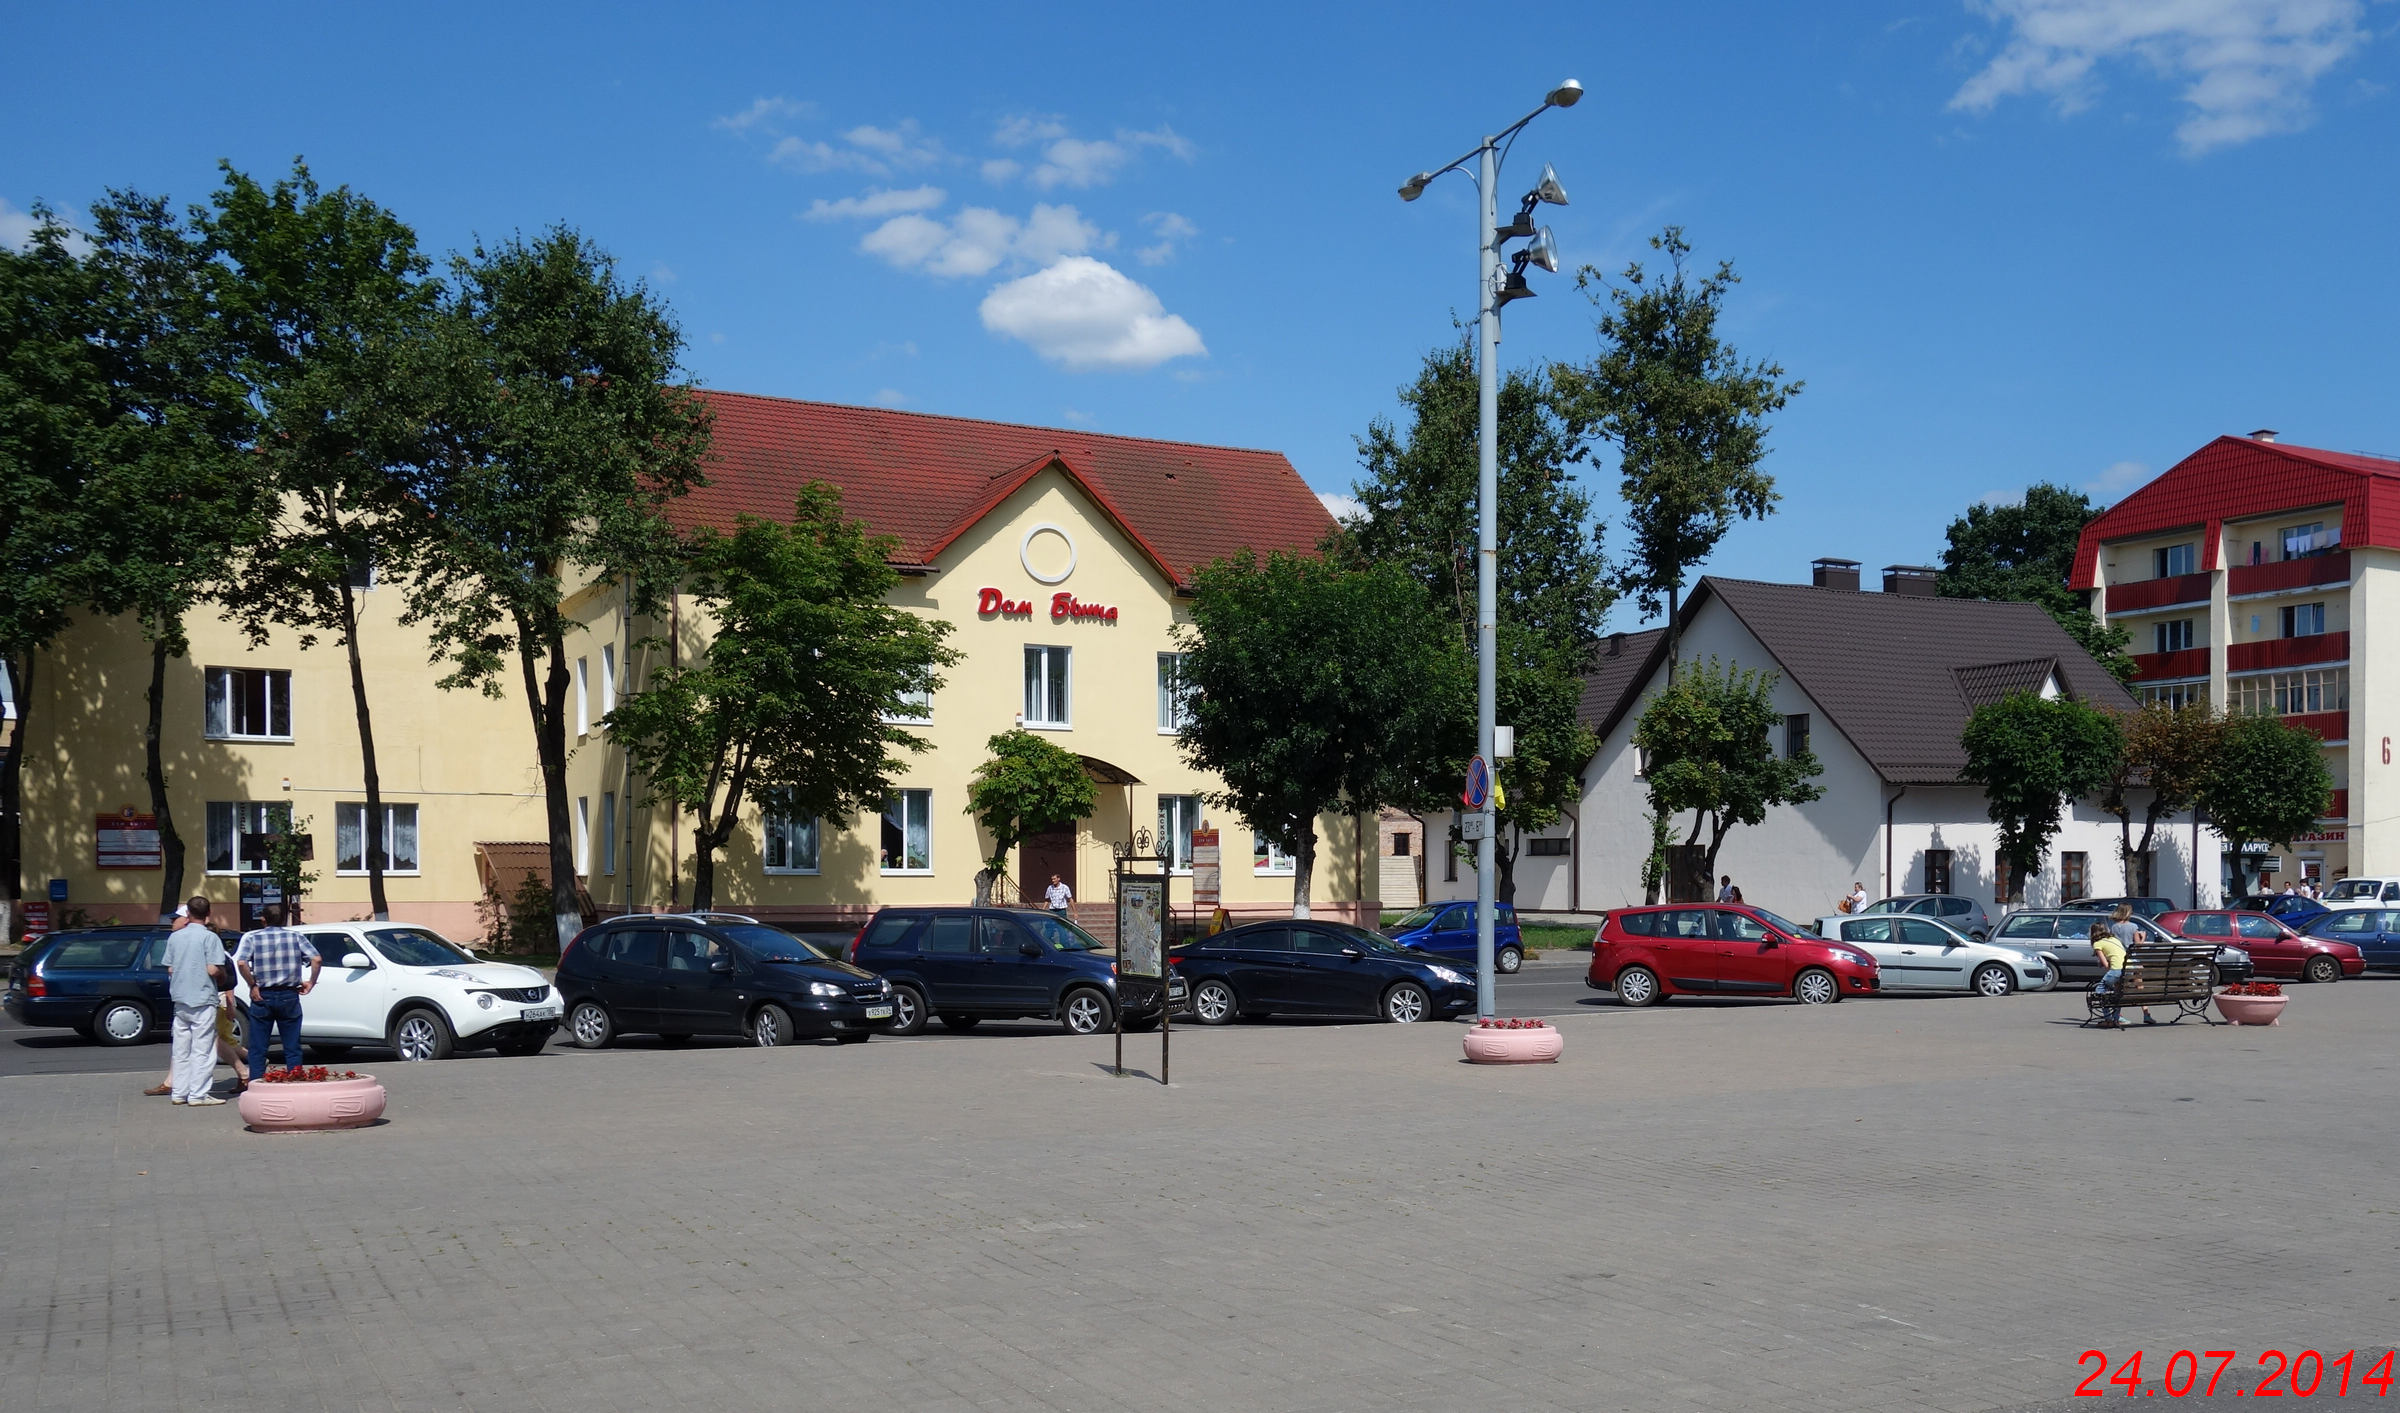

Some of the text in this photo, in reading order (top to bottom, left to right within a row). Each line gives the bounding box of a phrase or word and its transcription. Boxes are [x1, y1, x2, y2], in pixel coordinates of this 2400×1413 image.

[978, 587, 1033, 615] Дом
[2382, 736, 2391, 765] 6
[2292, 832, 2345, 842] ГАЗИН
